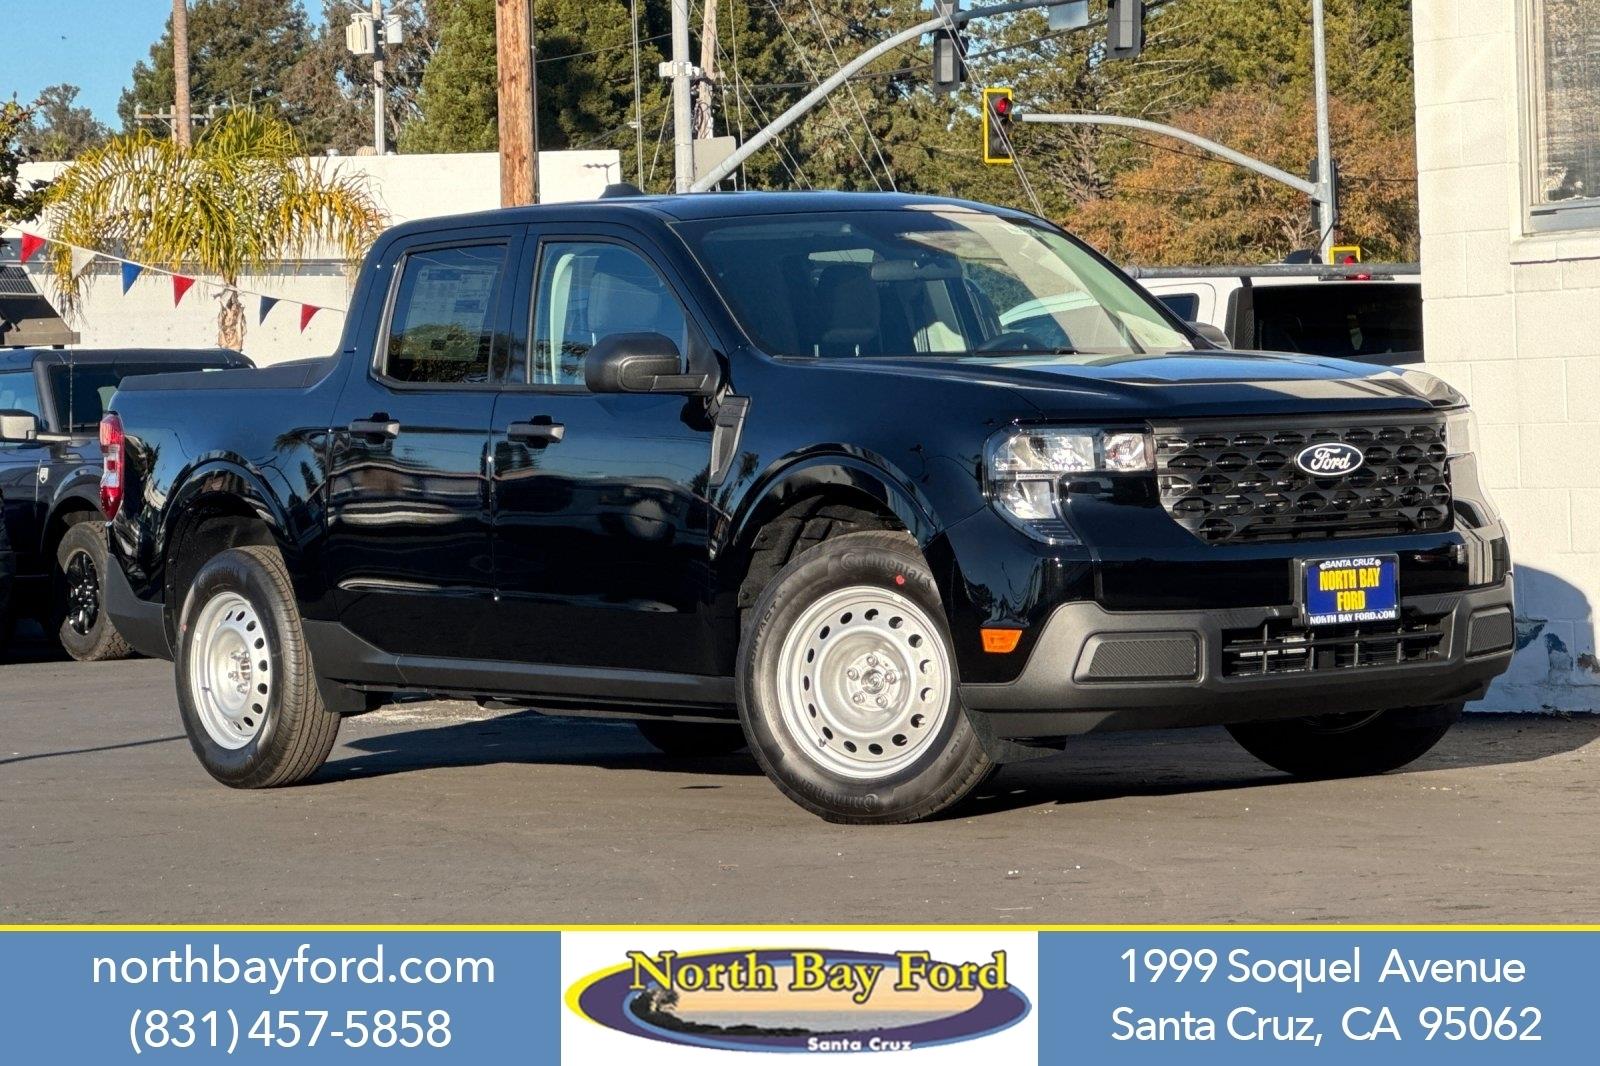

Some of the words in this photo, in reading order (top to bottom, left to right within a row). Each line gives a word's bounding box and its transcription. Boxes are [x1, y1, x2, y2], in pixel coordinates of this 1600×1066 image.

[1311, 447, 1351, 470] Ford
[1325, 559, 1351, 568] SANTA
[1353, 558, 1375, 566] CRUZ
[1320, 569, 1357, 591] NORTH
[1359, 567, 1380, 588] BAY
[1337, 591, 1365, 611] FORD
[1310, 614, 1336, 625] NORTH
[1338, 613, 1353, 622] BAY
[1355, 610, 1396, 621] FORD.COM
